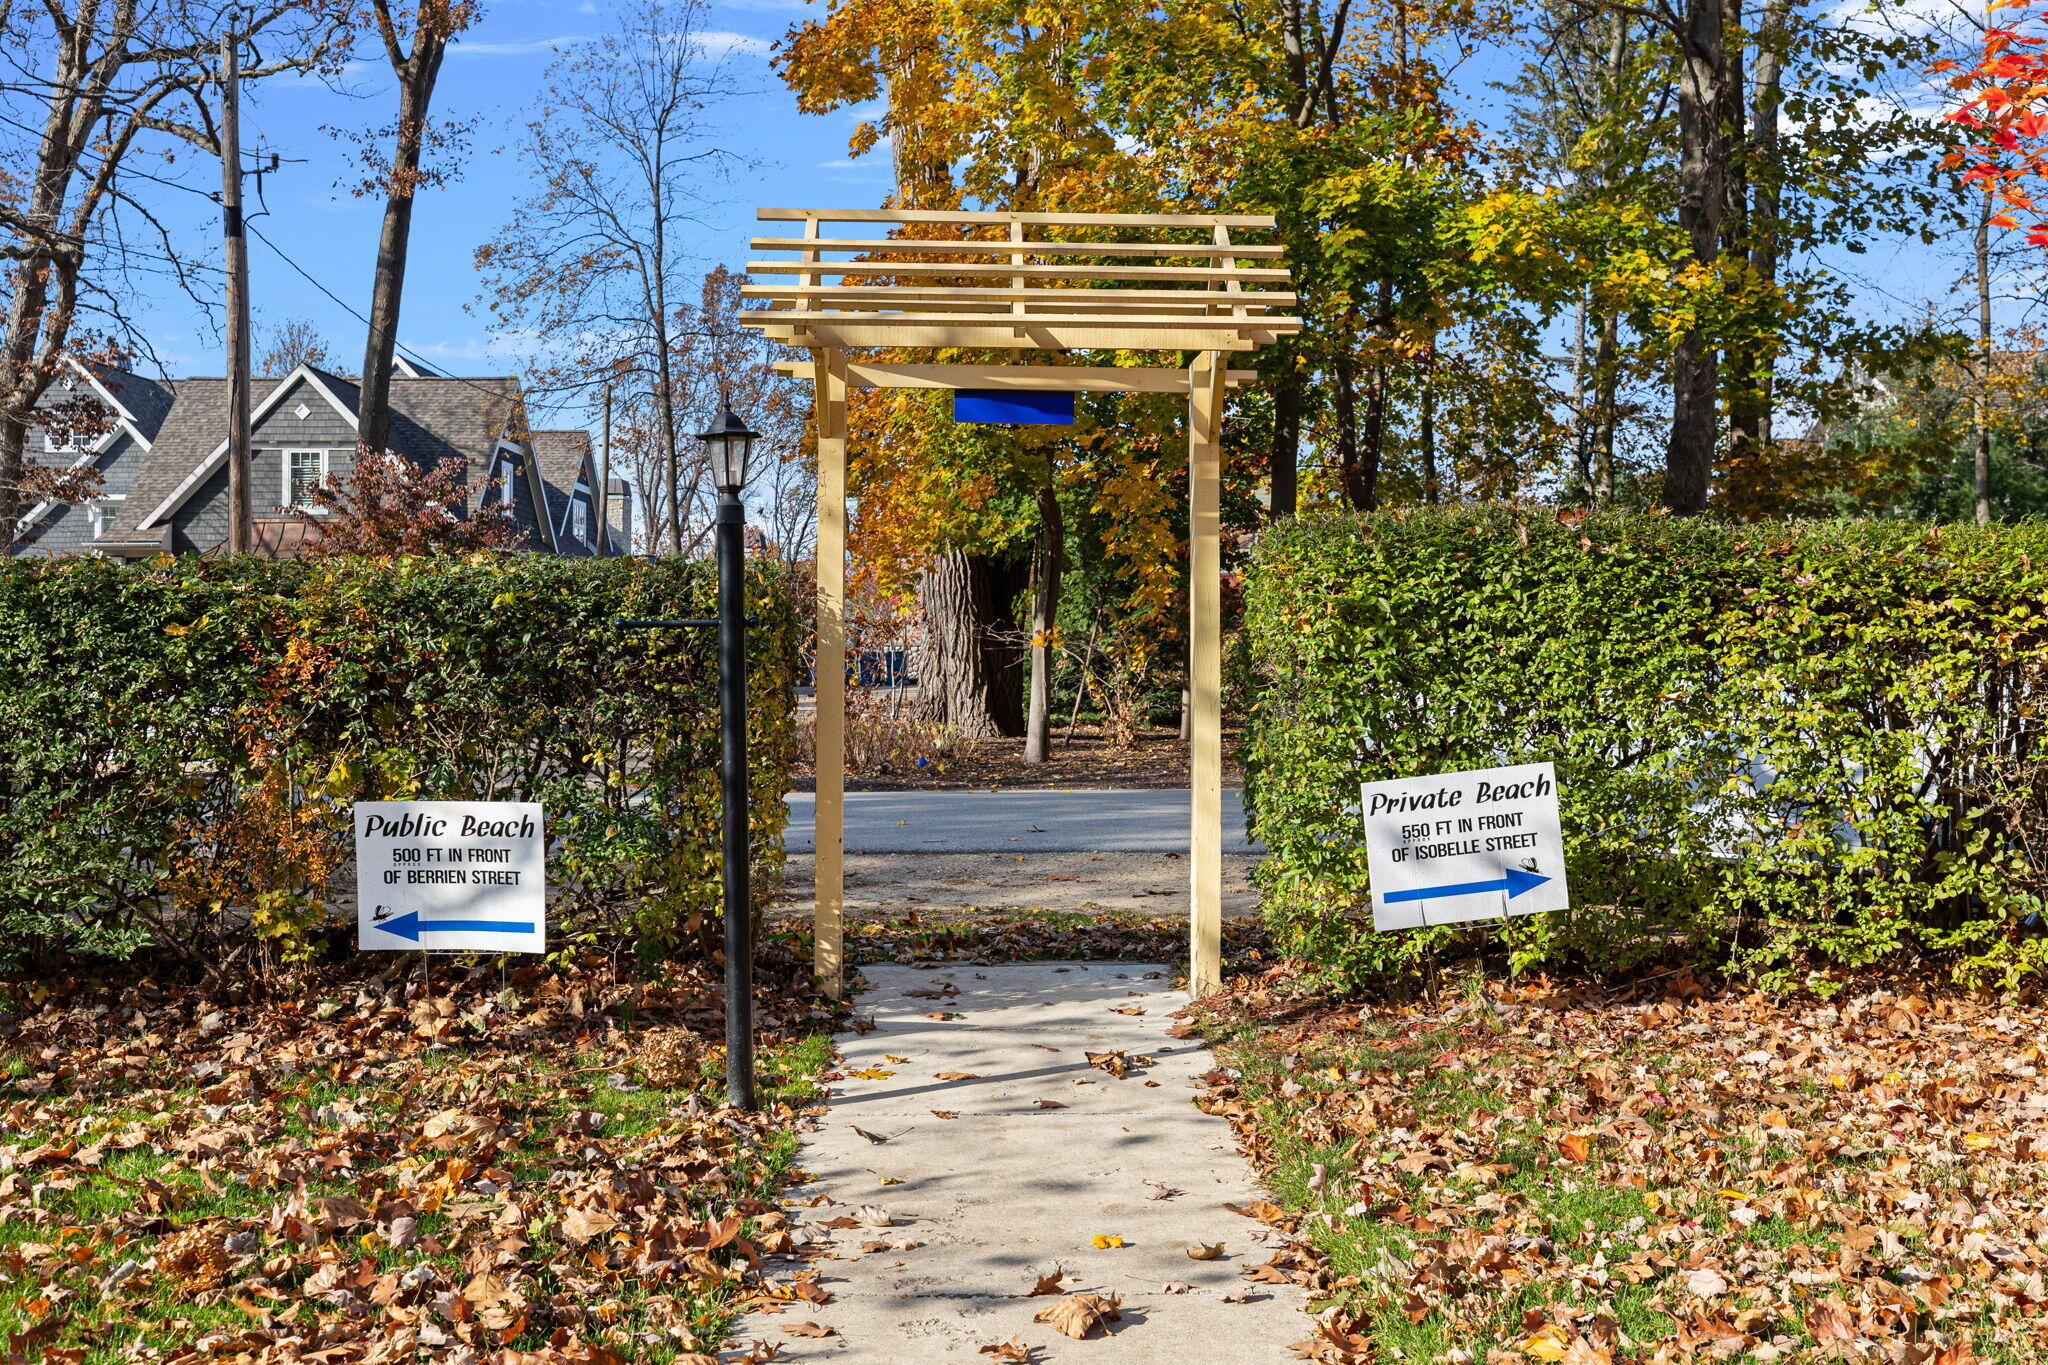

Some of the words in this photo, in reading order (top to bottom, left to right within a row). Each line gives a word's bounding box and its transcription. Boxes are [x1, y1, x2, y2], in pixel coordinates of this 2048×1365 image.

[1370, 788, 1462, 816] Private
[1476, 774, 1550, 803] Beach
[365, 813, 447, 837] Public
[461, 814, 535, 837] Beach
[1402, 824, 1429, 839] 550
[1436, 820, 1452, 835] FT
[1458, 819, 1472, 833] IN
[1479, 812, 1523, 831] FRONT
[393, 848, 420, 862] 500
[427, 848, 442, 862] FT
[449, 848, 462, 862] IN
[469, 849, 511, 863] FRONT
[1392, 848, 1409, 862] OF
[1416, 840, 1480, 860] ISOBELLE
[1486, 833, 1537, 850] STREET
[384, 870, 401, 884] OF
[408, 871, 466, 884] BERRIEN
[472, 871, 520, 885] STREET
